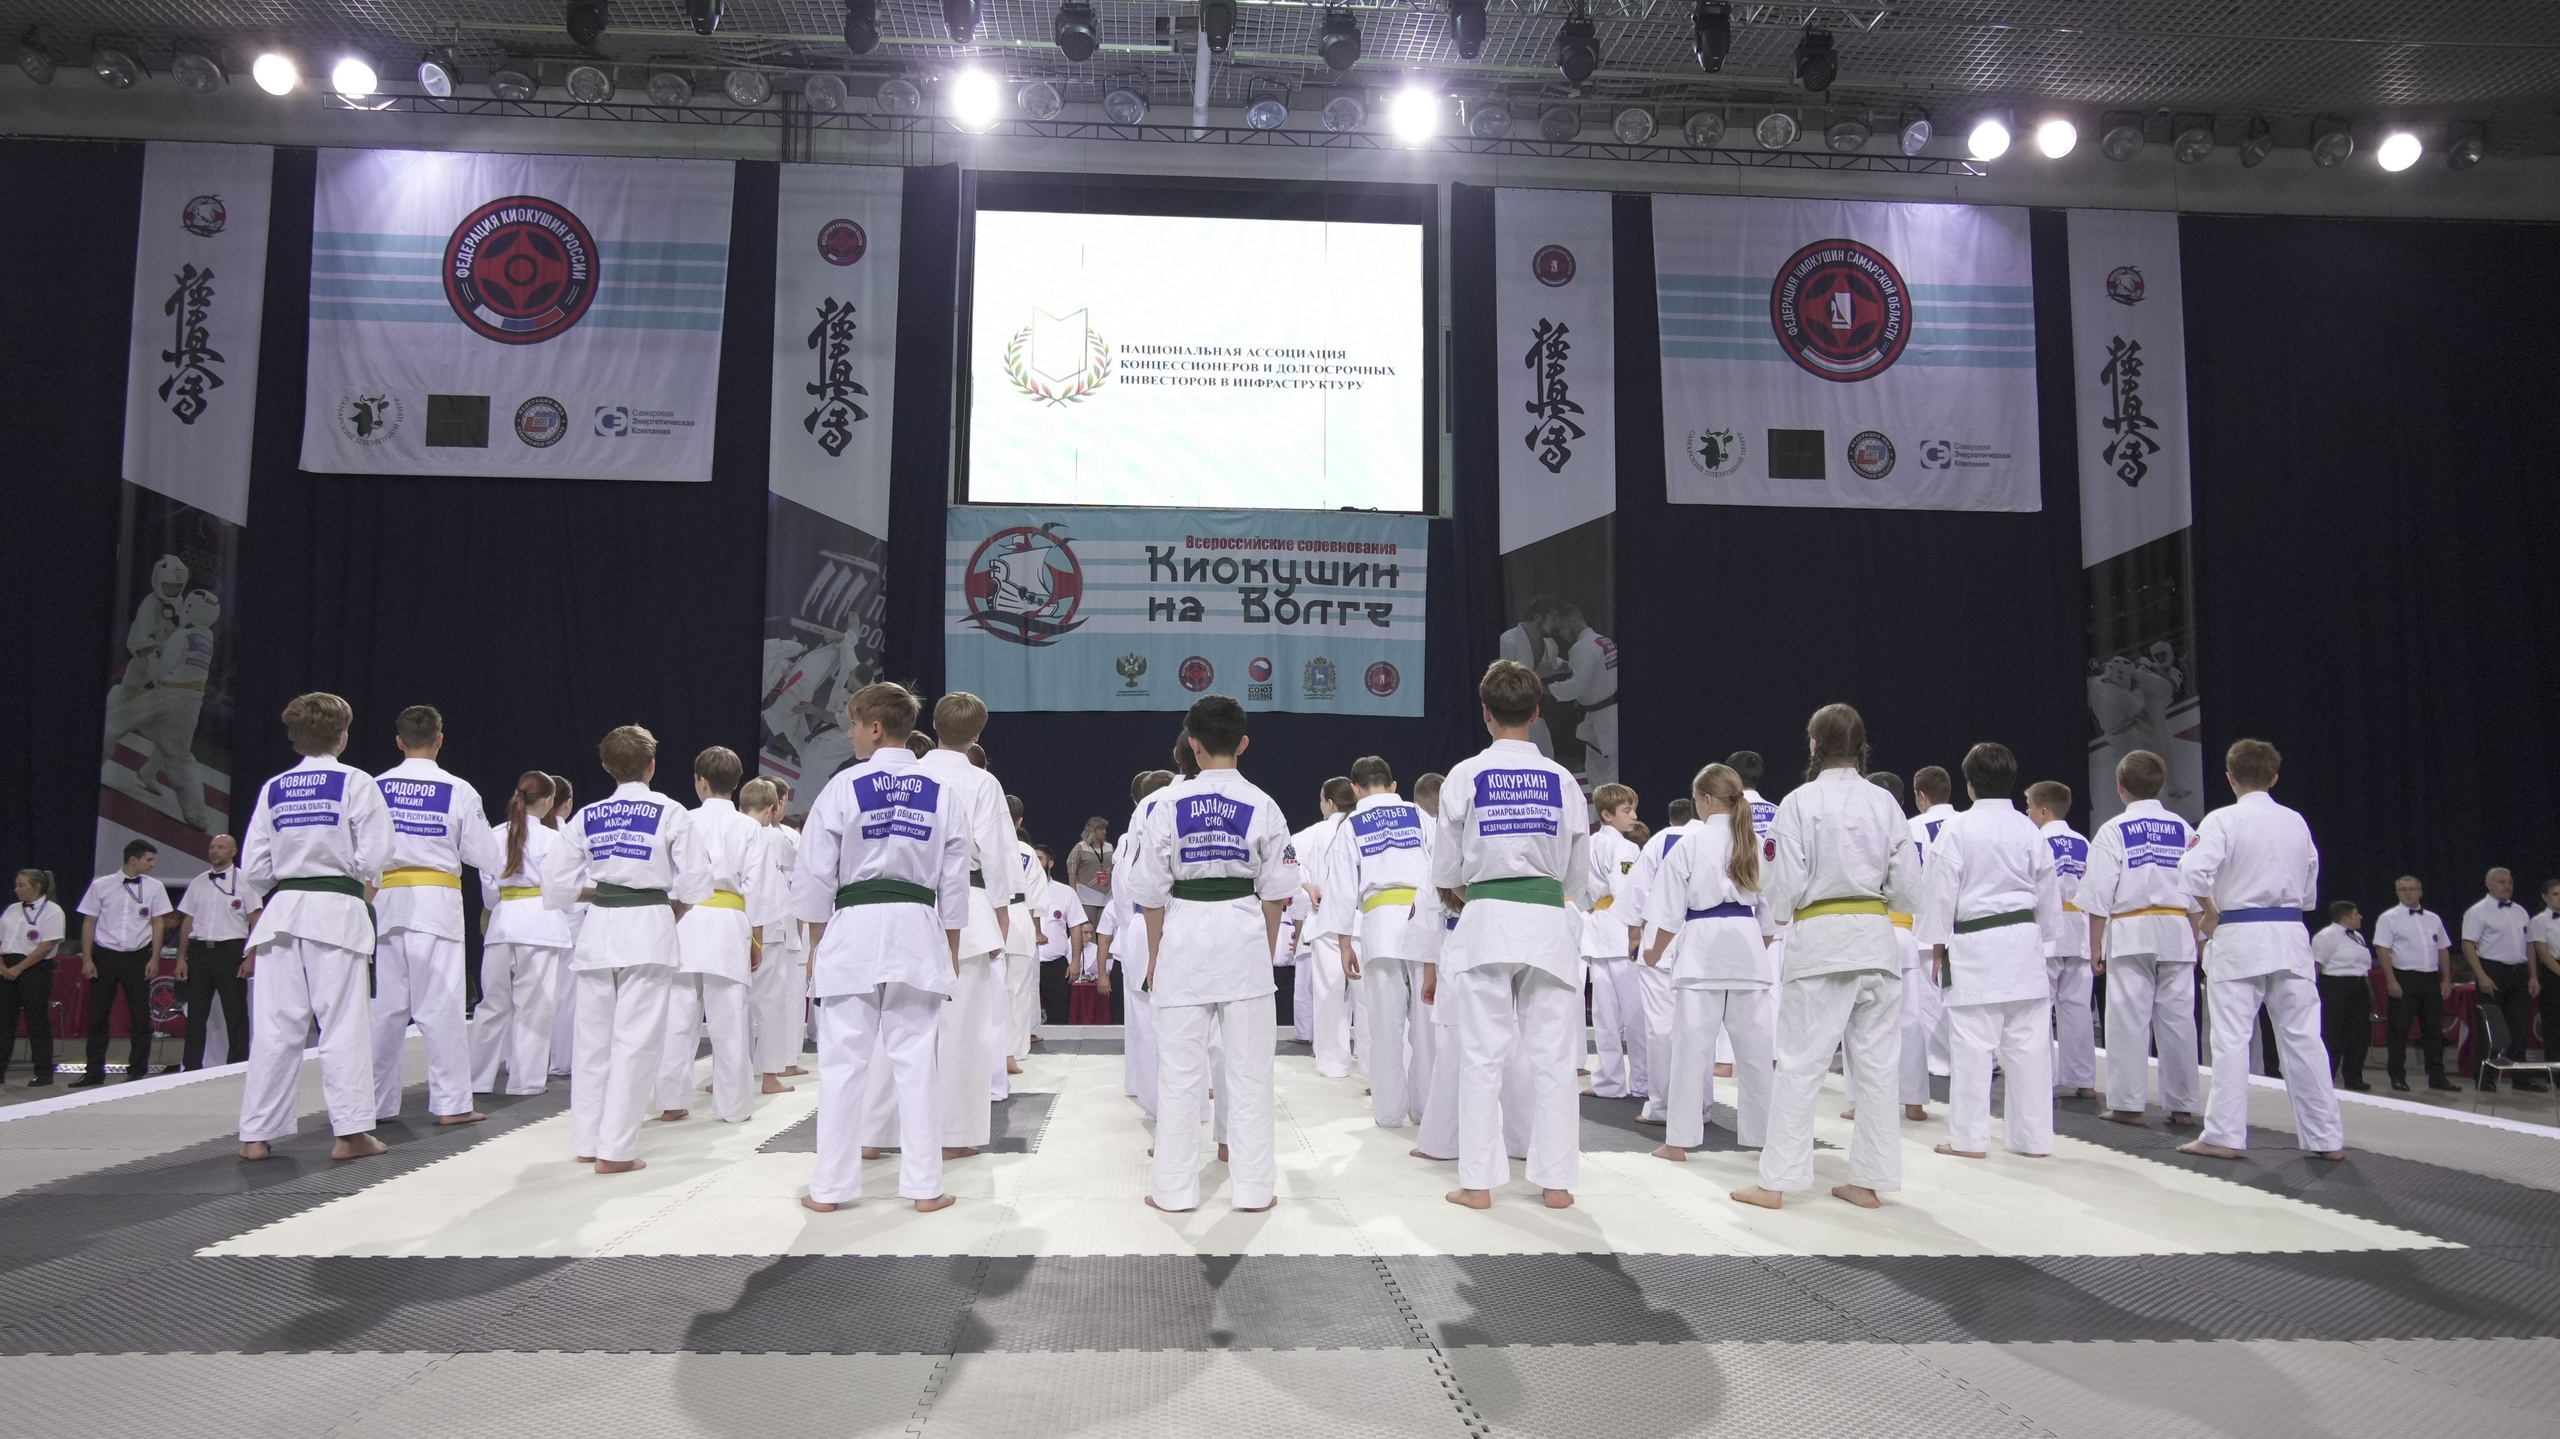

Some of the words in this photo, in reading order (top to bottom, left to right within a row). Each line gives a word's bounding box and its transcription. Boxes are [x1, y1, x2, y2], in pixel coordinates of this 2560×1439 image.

[456, 214, 500, 278] ФЕДЕРАЦИЯ
[500, 208, 568, 237] КИОКУШИН
[563, 233, 587, 280] РОССИИ
[1782, 276, 1799, 336] ФЕДЕРАЦИЯ
[1794, 250, 1844, 278] КИОКУШИН
[1847, 251, 1897, 295] САМАРСКОЙ
[1884, 296, 1900, 340] ОБЛАСТИ
[1121, 344, 1241, 357] НАЦИОНАЛЬНАЯ
[1246, 348, 1346, 360] АССОЦИАЦИЯ
[1120, 360, 1259, 372] КОНЦЕССИОНЕРОВ
[1263, 363, 1272, 372] И
[1276, 364, 1396, 376] ДОЛГОСРОЧНЫХ
[1120, 375, 1217, 387] ИНВЕСТОРОВ
[1221, 378, 1229, 387] В
[1234, 378, 1364, 390] ИНФРАСТРУКТУРУ
[632, 409, 673, 417] Самарская
[632, 418, 695, 427] Энергетическая
[631, 427, 671, 435] Компания
[1954, 460, 1990, 468] Компания
[1186, 535, 1294, 551] Всероссийские
[1297, 541, 1397, 555] соревнования
[1148, 596, 1205, 622] на
[1238, 586, 1393, 627] Волге
[280, 773, 327, 790] НОВИКОВ
[1487, 773, 1548, 789] КОКУРКИН
[285, 788, 316, 798] МАКСИМ
[384, 781, 436, 797] СИДОРОВ
[1489, 789, 1549, 801] МАКСИМИЛИАН
[394, 796, 424, 807] МИХАИЛ
[406, 812, 444, 822] РЕСПУБЛИКА
[1487, 808, 1525, 817] САМАРСКАЯ
[1482, 822, 1512, 832] ФЕДЕРАЦИЯ
